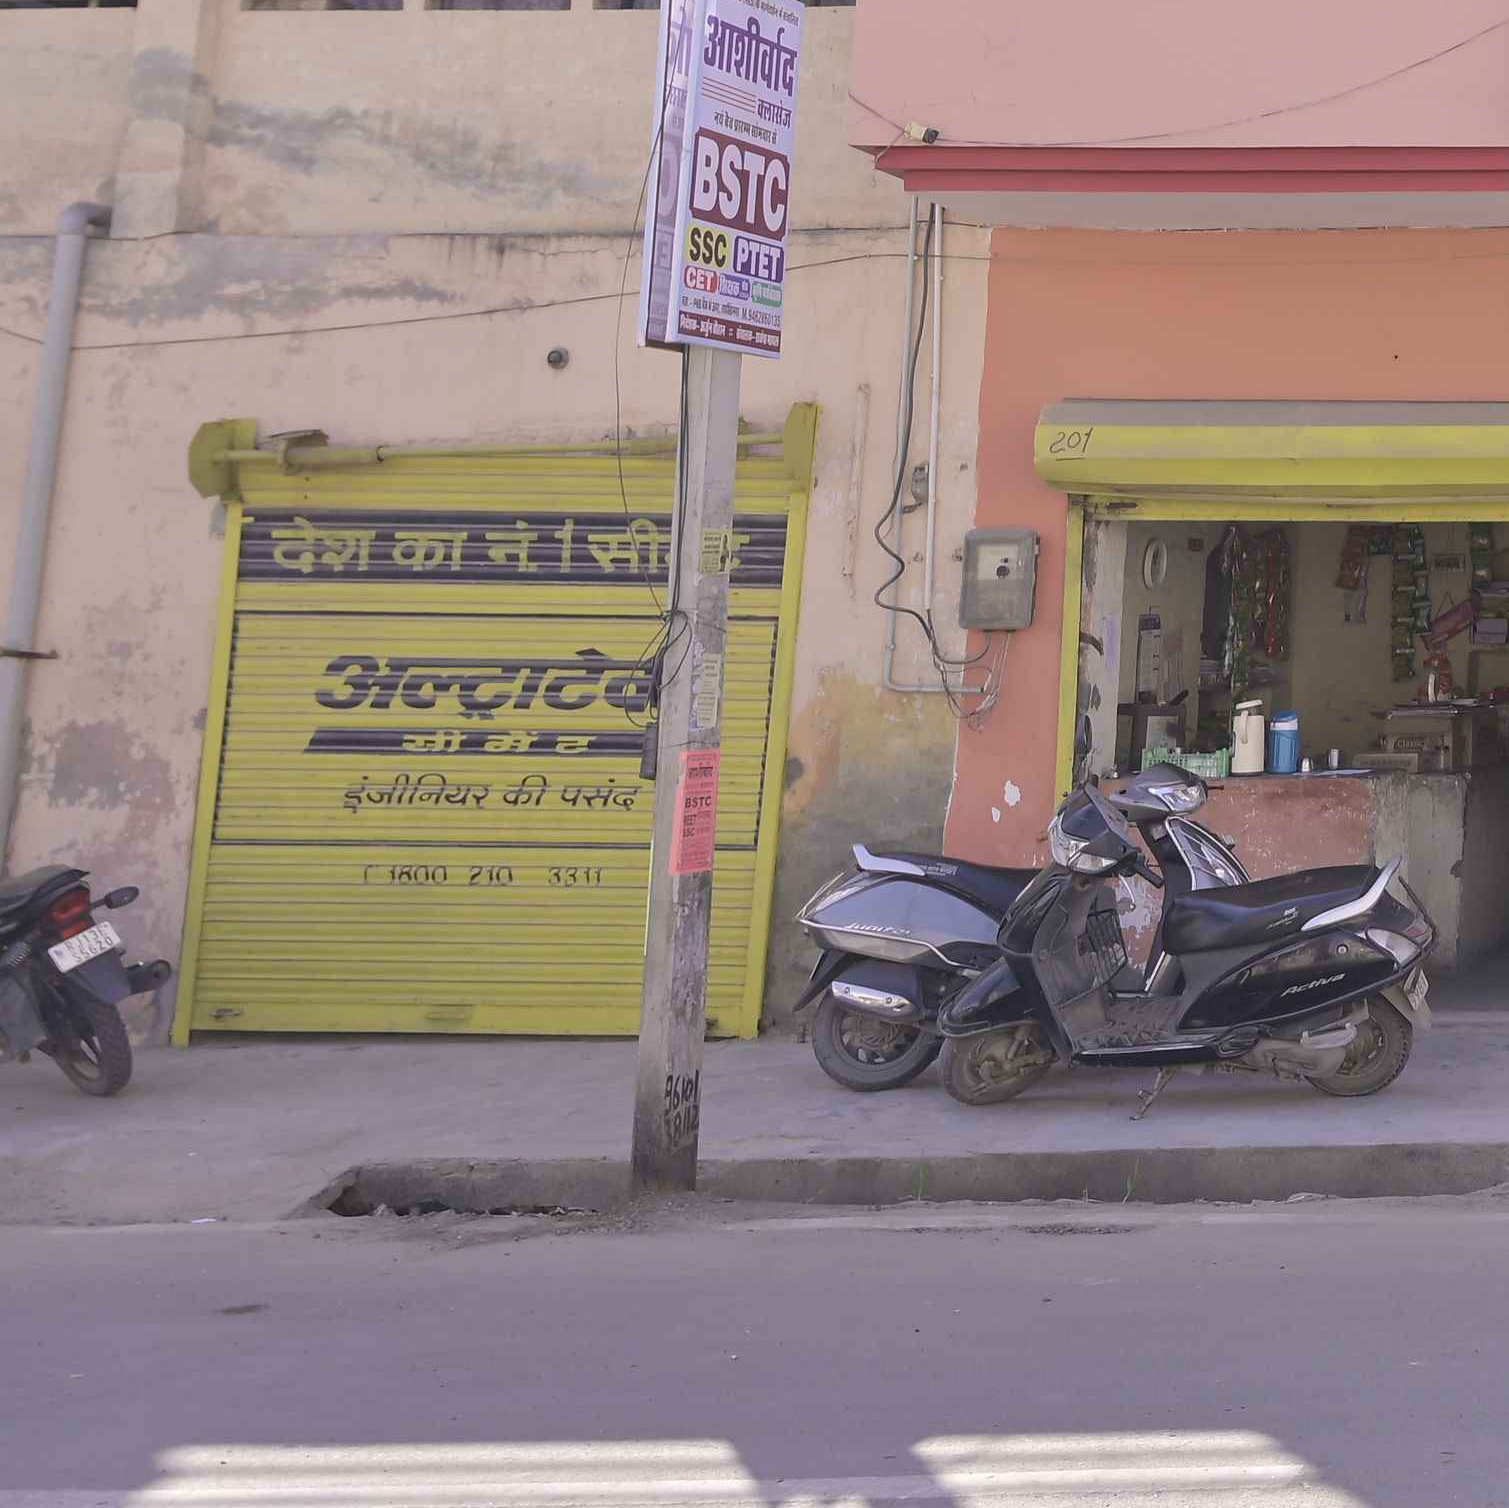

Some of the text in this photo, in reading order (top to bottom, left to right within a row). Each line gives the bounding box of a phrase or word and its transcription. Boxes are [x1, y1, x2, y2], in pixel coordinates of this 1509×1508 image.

[703, 14, 798, 97] आशीर्वाद
[693, 135, 787, 233] BSTC
[690, 228, 781, 281] SSC PTET
[685, 266, 714, 292] CET
[1048, 426, 1095, 456] 201
[271, 516, 377, 574] देश
[392, 530, 470, 573] का
[343, 773, 643, 814] इंजीनियर की पसंद
[684, 795, 712, 809] BSTC
[1280, 972, 1346, 998] Activa
